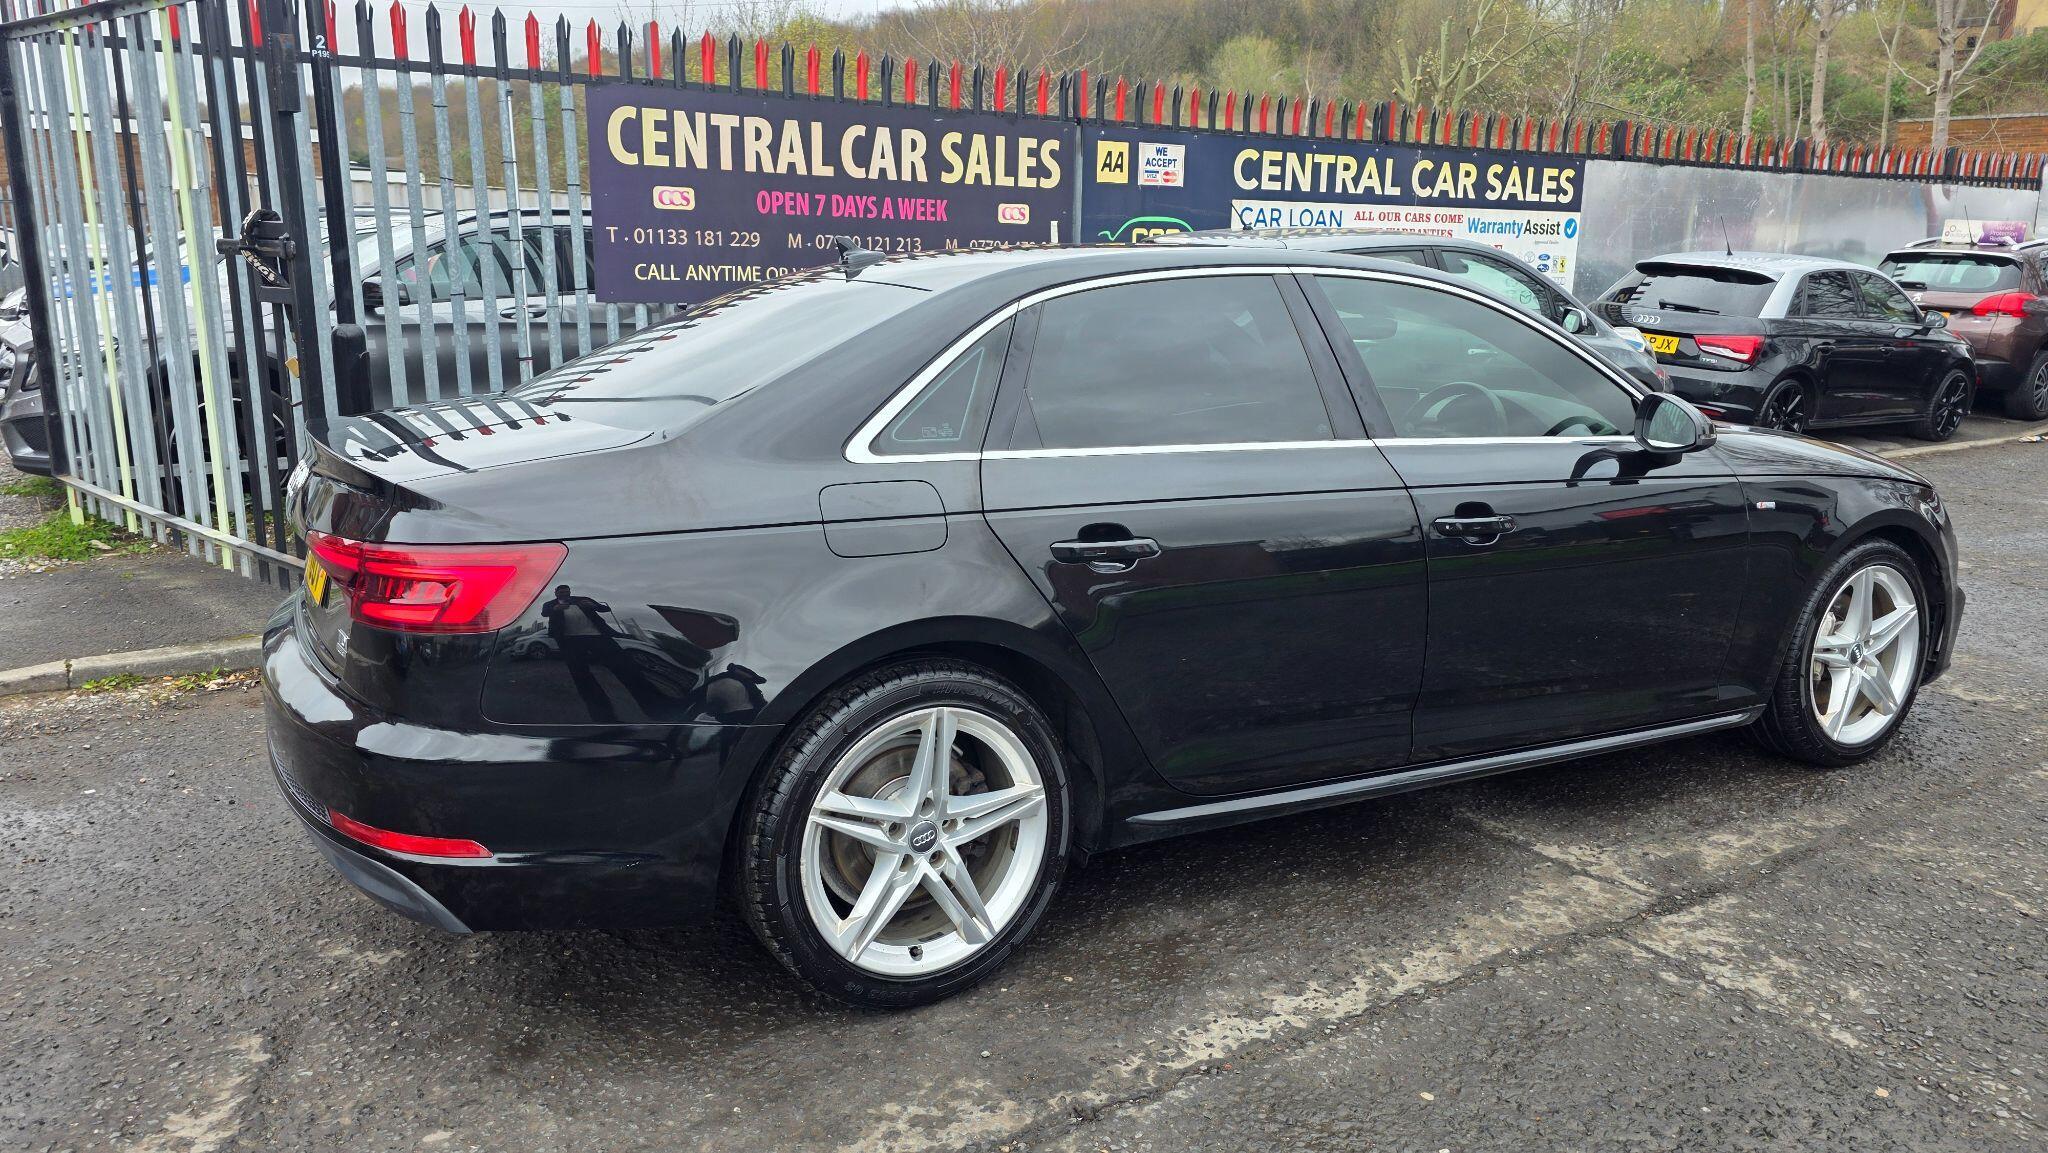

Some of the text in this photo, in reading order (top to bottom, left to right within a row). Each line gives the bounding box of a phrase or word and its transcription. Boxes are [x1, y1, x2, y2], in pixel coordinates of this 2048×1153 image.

[315, 34, 326, 49] 2
[607, 105, 1061, 189] CENTRAL CAR SALES
[1155, 146, 1168, 157] WE
[1101, 151, 1124, 173] AA
[1145, 157, 1178, 168] ACCEPT
[1233, 149, 1576, 204] CENTRAL CAR SALES
[756, 190, 948, 222] OPEN 7 DAYS A WEEK
[1240, 206, 1343, 228] CAR LOAN
[1354, 210, 1464, 224] ALL OUR CARS COME
[633, 228, 688, 245] 01133
[695, 230, 723, 246] 181
[730, 232, 761, 248] 229
[866, 236, 890, 251] 121
[896, 238, 921, 252] 213
[634, 263, 681, 282] CALL
[685, 264, 762, 282] ANYTIME
